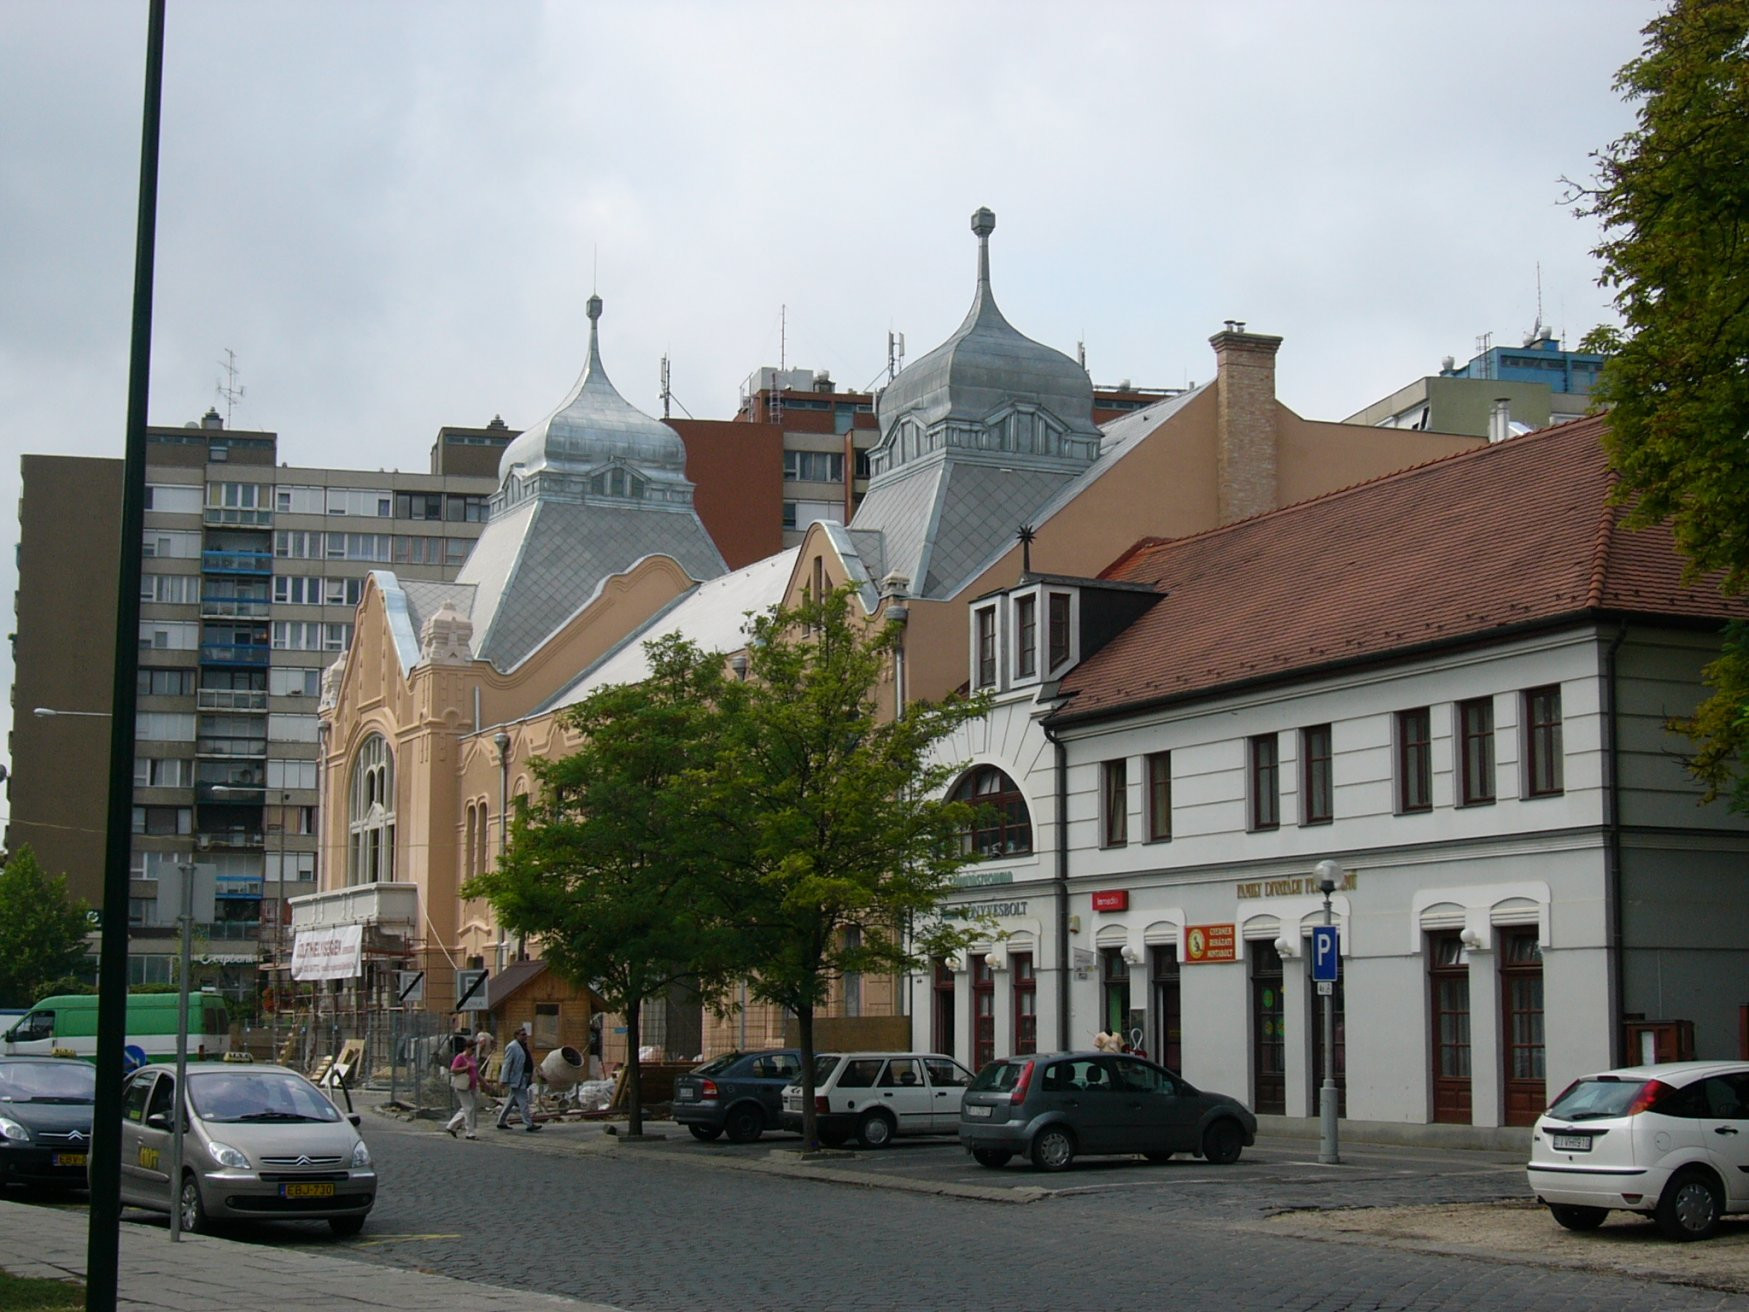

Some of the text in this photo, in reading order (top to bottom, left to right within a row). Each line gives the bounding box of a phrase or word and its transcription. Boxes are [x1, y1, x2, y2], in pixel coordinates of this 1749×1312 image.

[1237, 882, 1262, 899] FAMILY
[1318, 934, 1331, 966] P
[287, 1185, 332, 1195] EBJ-730
